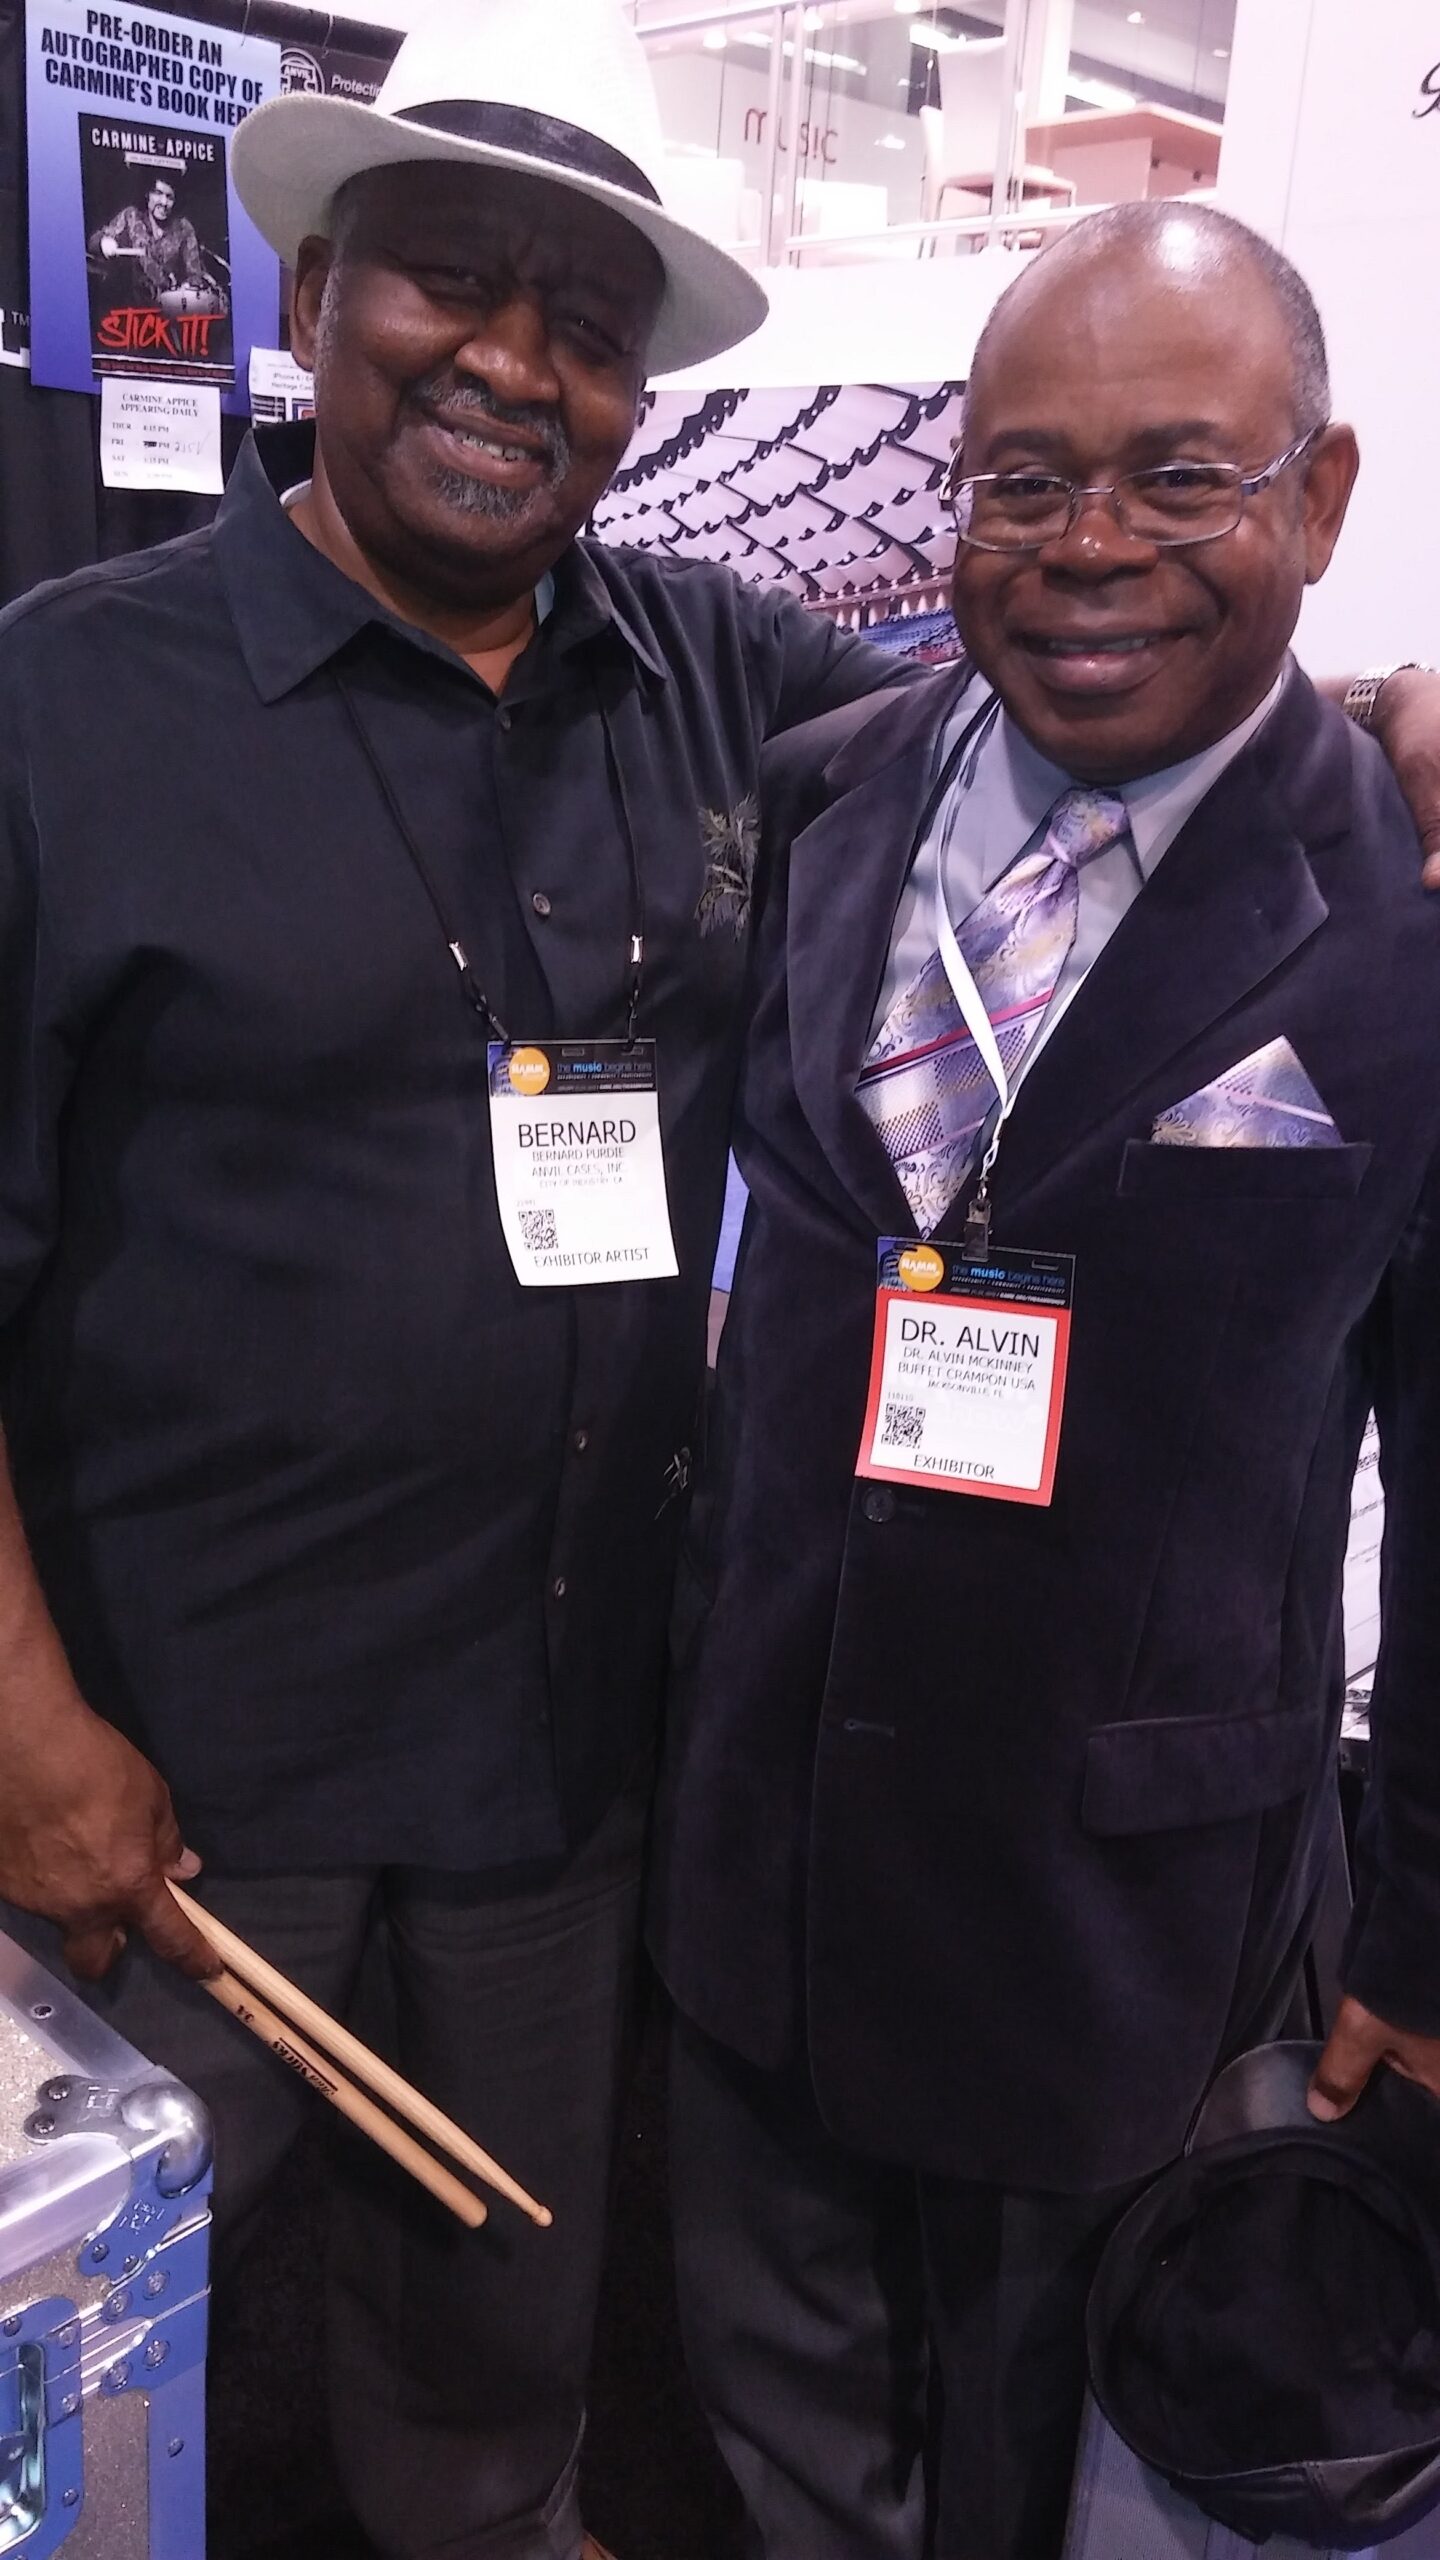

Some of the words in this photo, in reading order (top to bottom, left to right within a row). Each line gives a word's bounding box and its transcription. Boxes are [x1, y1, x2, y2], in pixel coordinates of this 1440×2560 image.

[87, 9, 193, 60] PRE-ORDER
[198, 40, 222, 67] AN
[41, 28, 183, 85] AUTOGRAPHED
[189, 66, 237, 99] COPY
[242, 79, 263, 105] OF
[45, 59, 152, 107] CARMINE'S
[158, 84, 209, 121] BOOK
[214, 93, 253, 126] HER
[91, 128, 156, 154] CARMINE
[166, 139, 215, 162] APPICE
[119, 403, 170, 415] APPEARING
[172, 407, 199, 417] DAILY
[122, 393, 162, 404] CARMINE
[166, 398, 198, 407] APPICE
[573, 1062, 602, 1073] music
[518, 1120, 636, 1148] BERNARD
[532, 1149, 582, 1162] BERNARD
[586, 1147, 623, 1160] PURDIE
[534, 1251, 602, 1267] EXHIBITOR
[606, 1247, 649, 1263] ARTIST
[970, 1265, 1006, 1280] music
[901, 1318, 945, 1346] DR.
[956, 1326, 1040, 1358] ALVIN
[928, 1350, 965, 1365] ALVIN
[968, 1354, 1033, 1374] MCKINNEY
[898, 1361, 942, 1377] BUFFET
[946, 1368, 1007, 1387] CRAMPON
[1011, 1376, 1036, 1391] USA
[914, 1454, 995, 1479] EXHIBITOR
